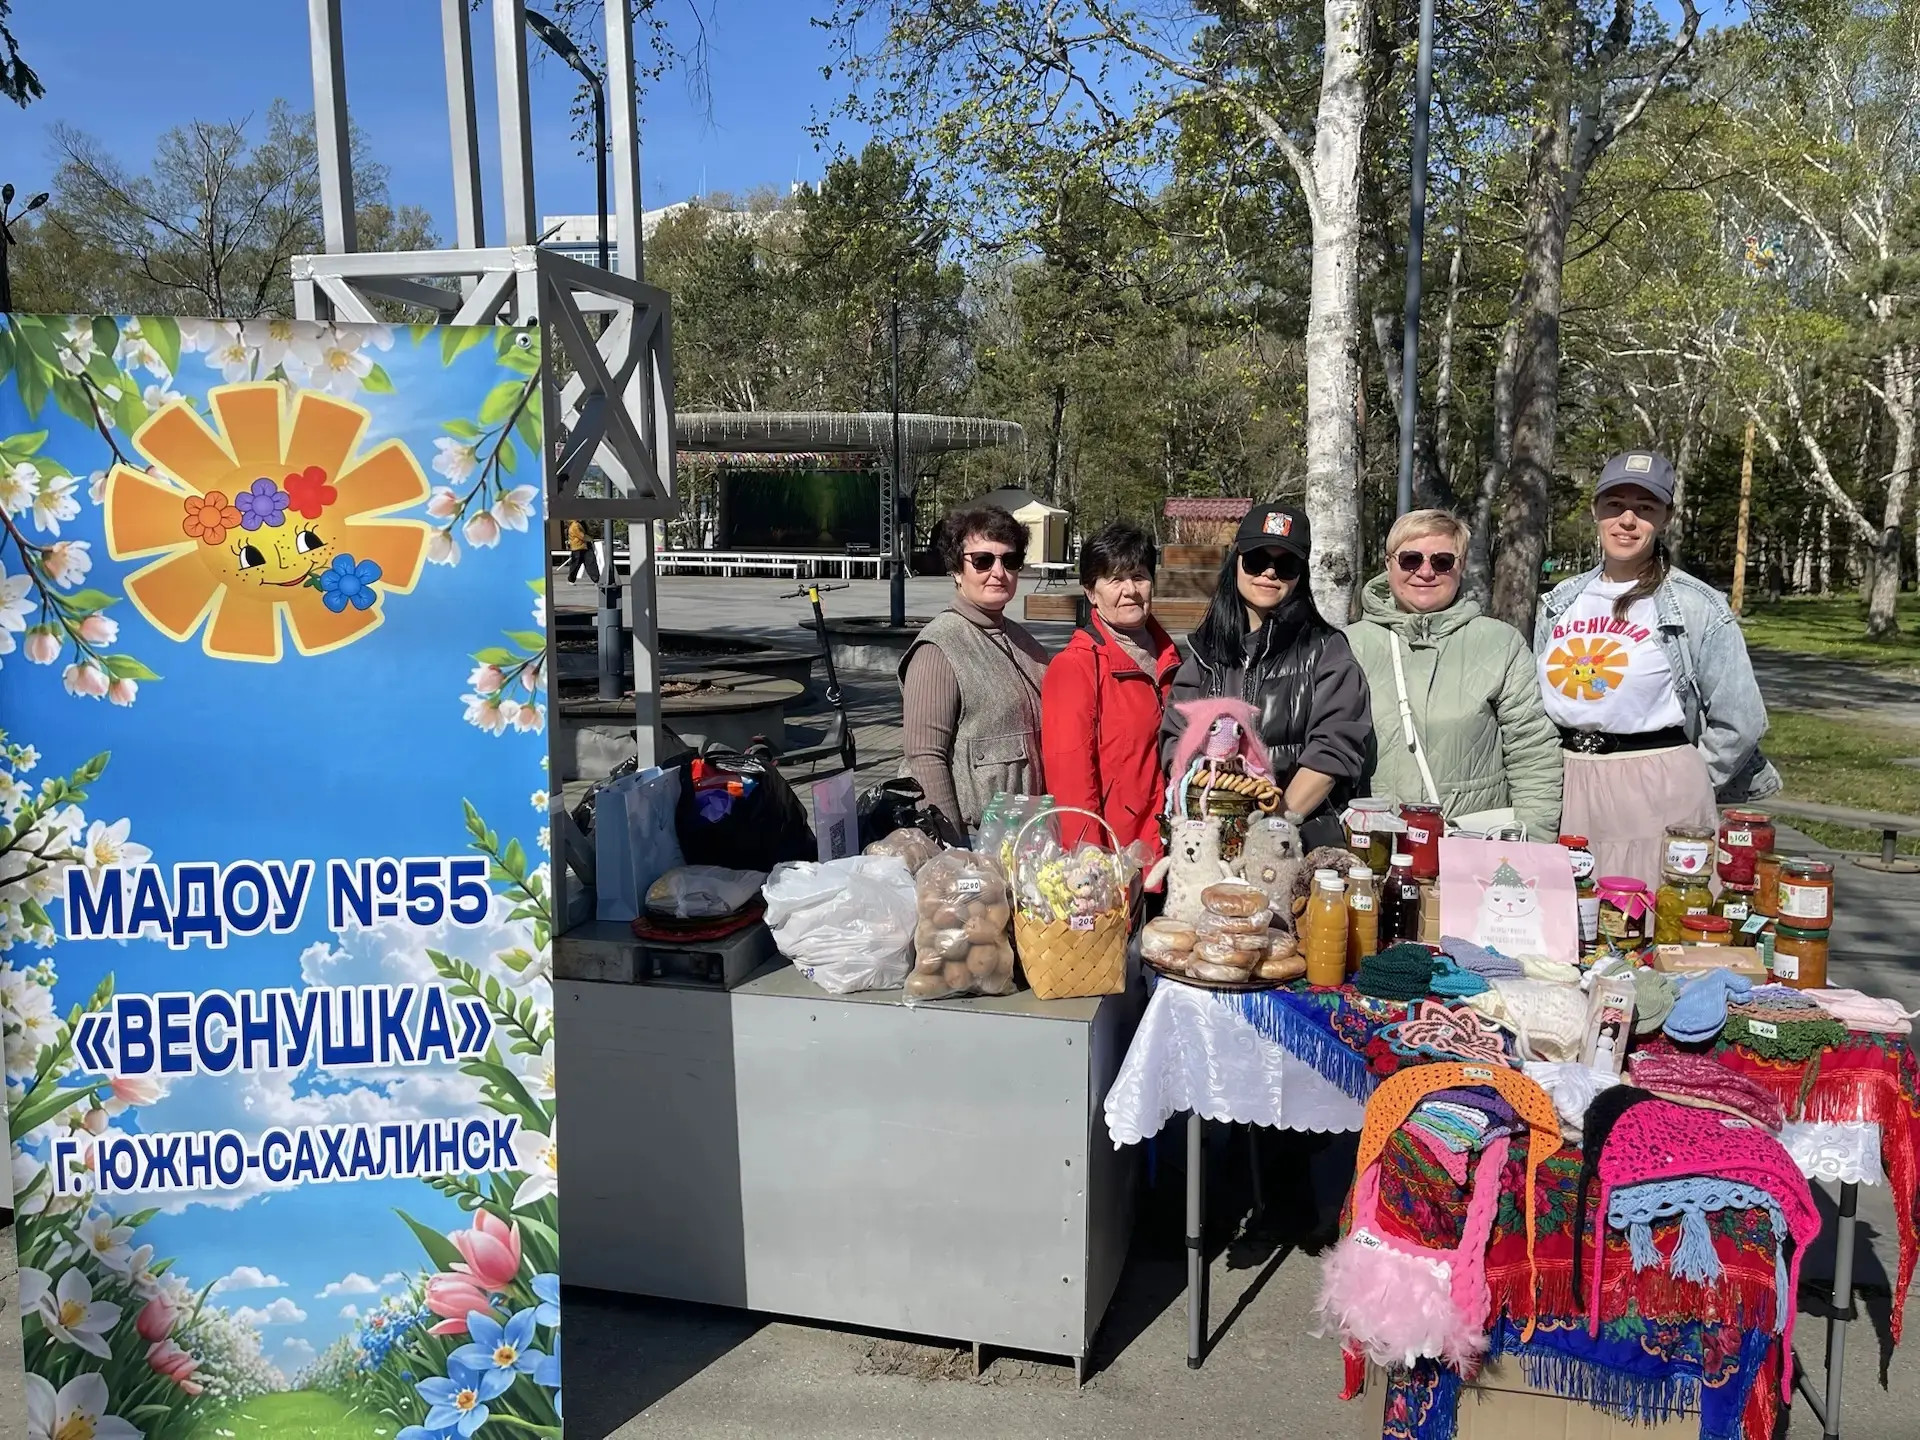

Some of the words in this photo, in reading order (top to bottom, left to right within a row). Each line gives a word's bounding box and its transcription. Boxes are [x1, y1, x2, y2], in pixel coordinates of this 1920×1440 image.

[66, 864, 311, 945] МАДОУ
[331, 859, 490, 927] №55
[1078, 917, 1094, 927] 200
[75, 987, 492, 1075] «ВЕСНУШКА»
[56, 1141, 83, 1193] Г.
[100, 1118, 519, 1190] ЮЖНО-САХАЛИНСК
